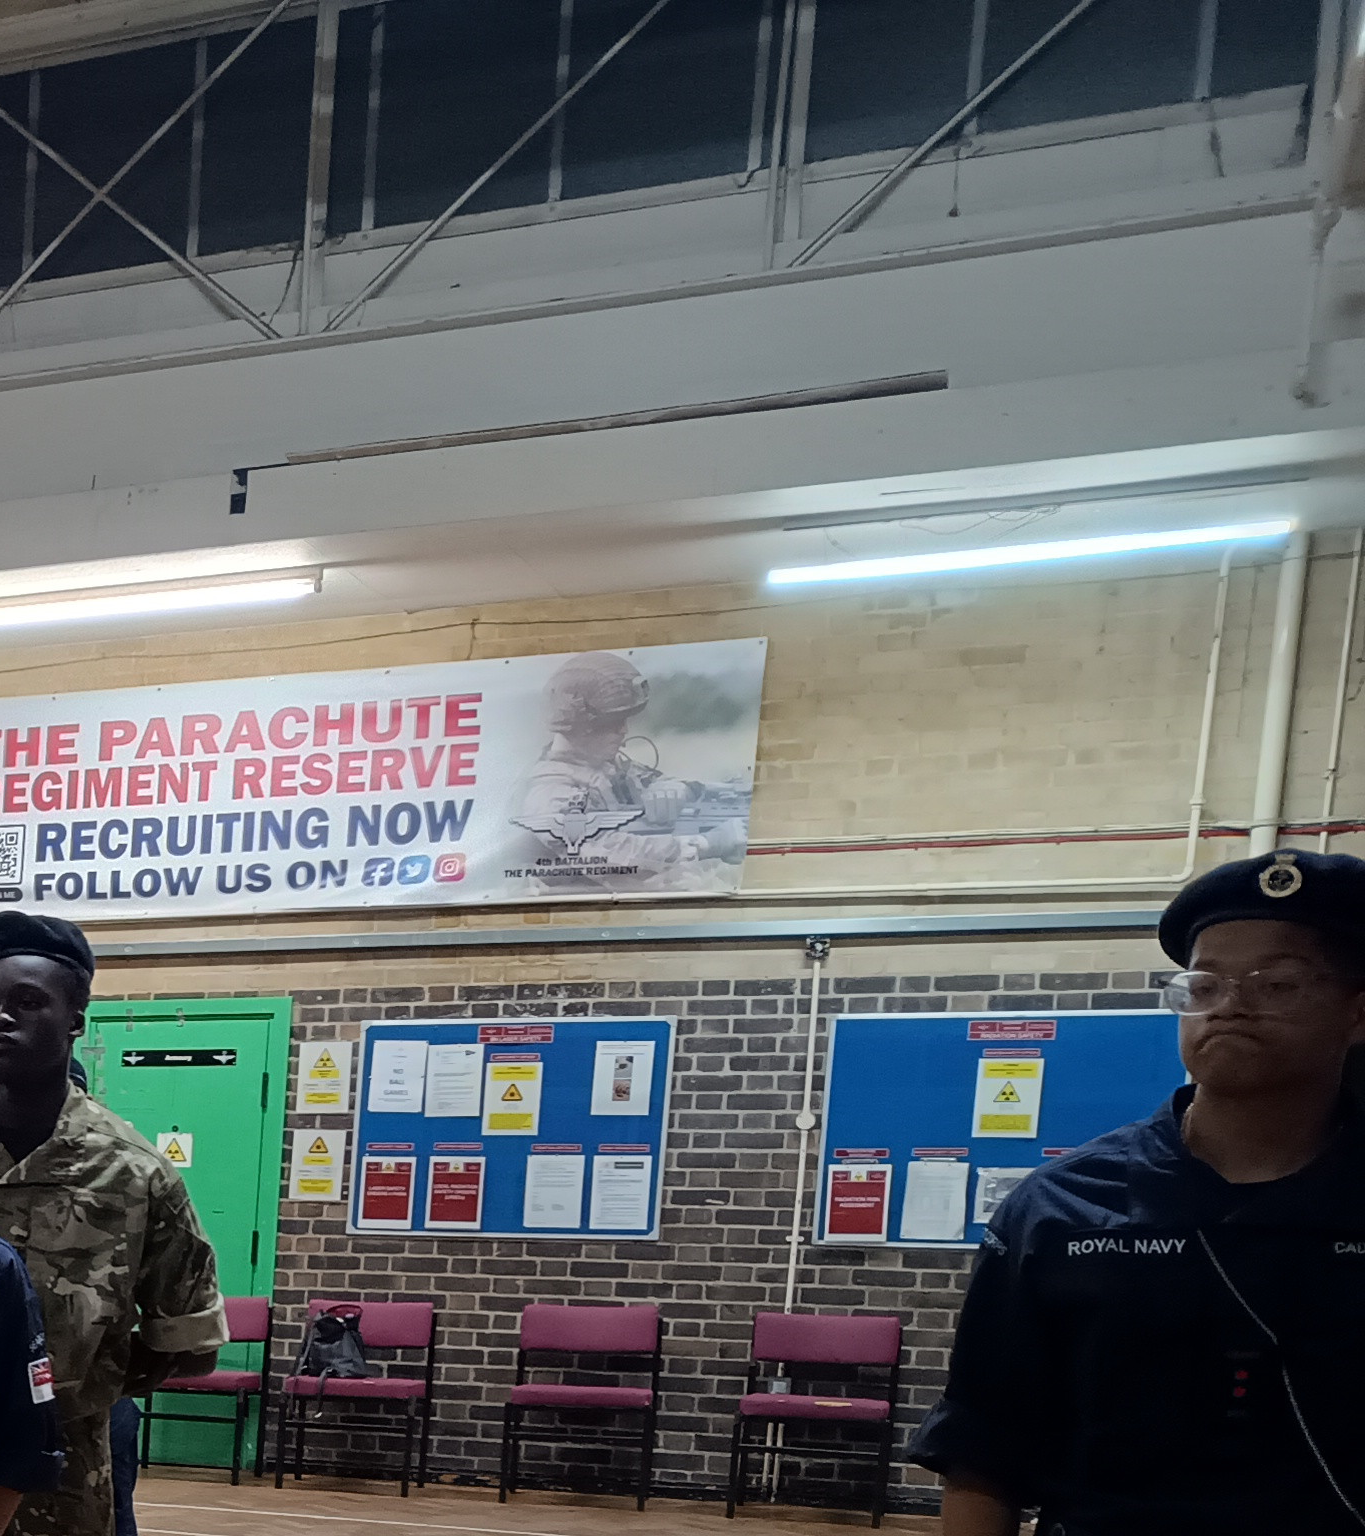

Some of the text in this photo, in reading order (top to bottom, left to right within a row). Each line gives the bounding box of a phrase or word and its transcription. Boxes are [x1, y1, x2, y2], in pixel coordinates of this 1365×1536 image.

[98, 693, 482, 762] PARACHUTE
[232, 742, 480, 800] RESERVE
[34, 798, 474, 862] RECRUITING NOW
[34, 859, 348, 901] FOLLOW US ON
[504, 865, 638, 878] THE PARACHUTE REGIMENT
[555, 856, 608, 866] BATTALION
[1068, 1238, 1186, 1256] ROYAL NAVY
